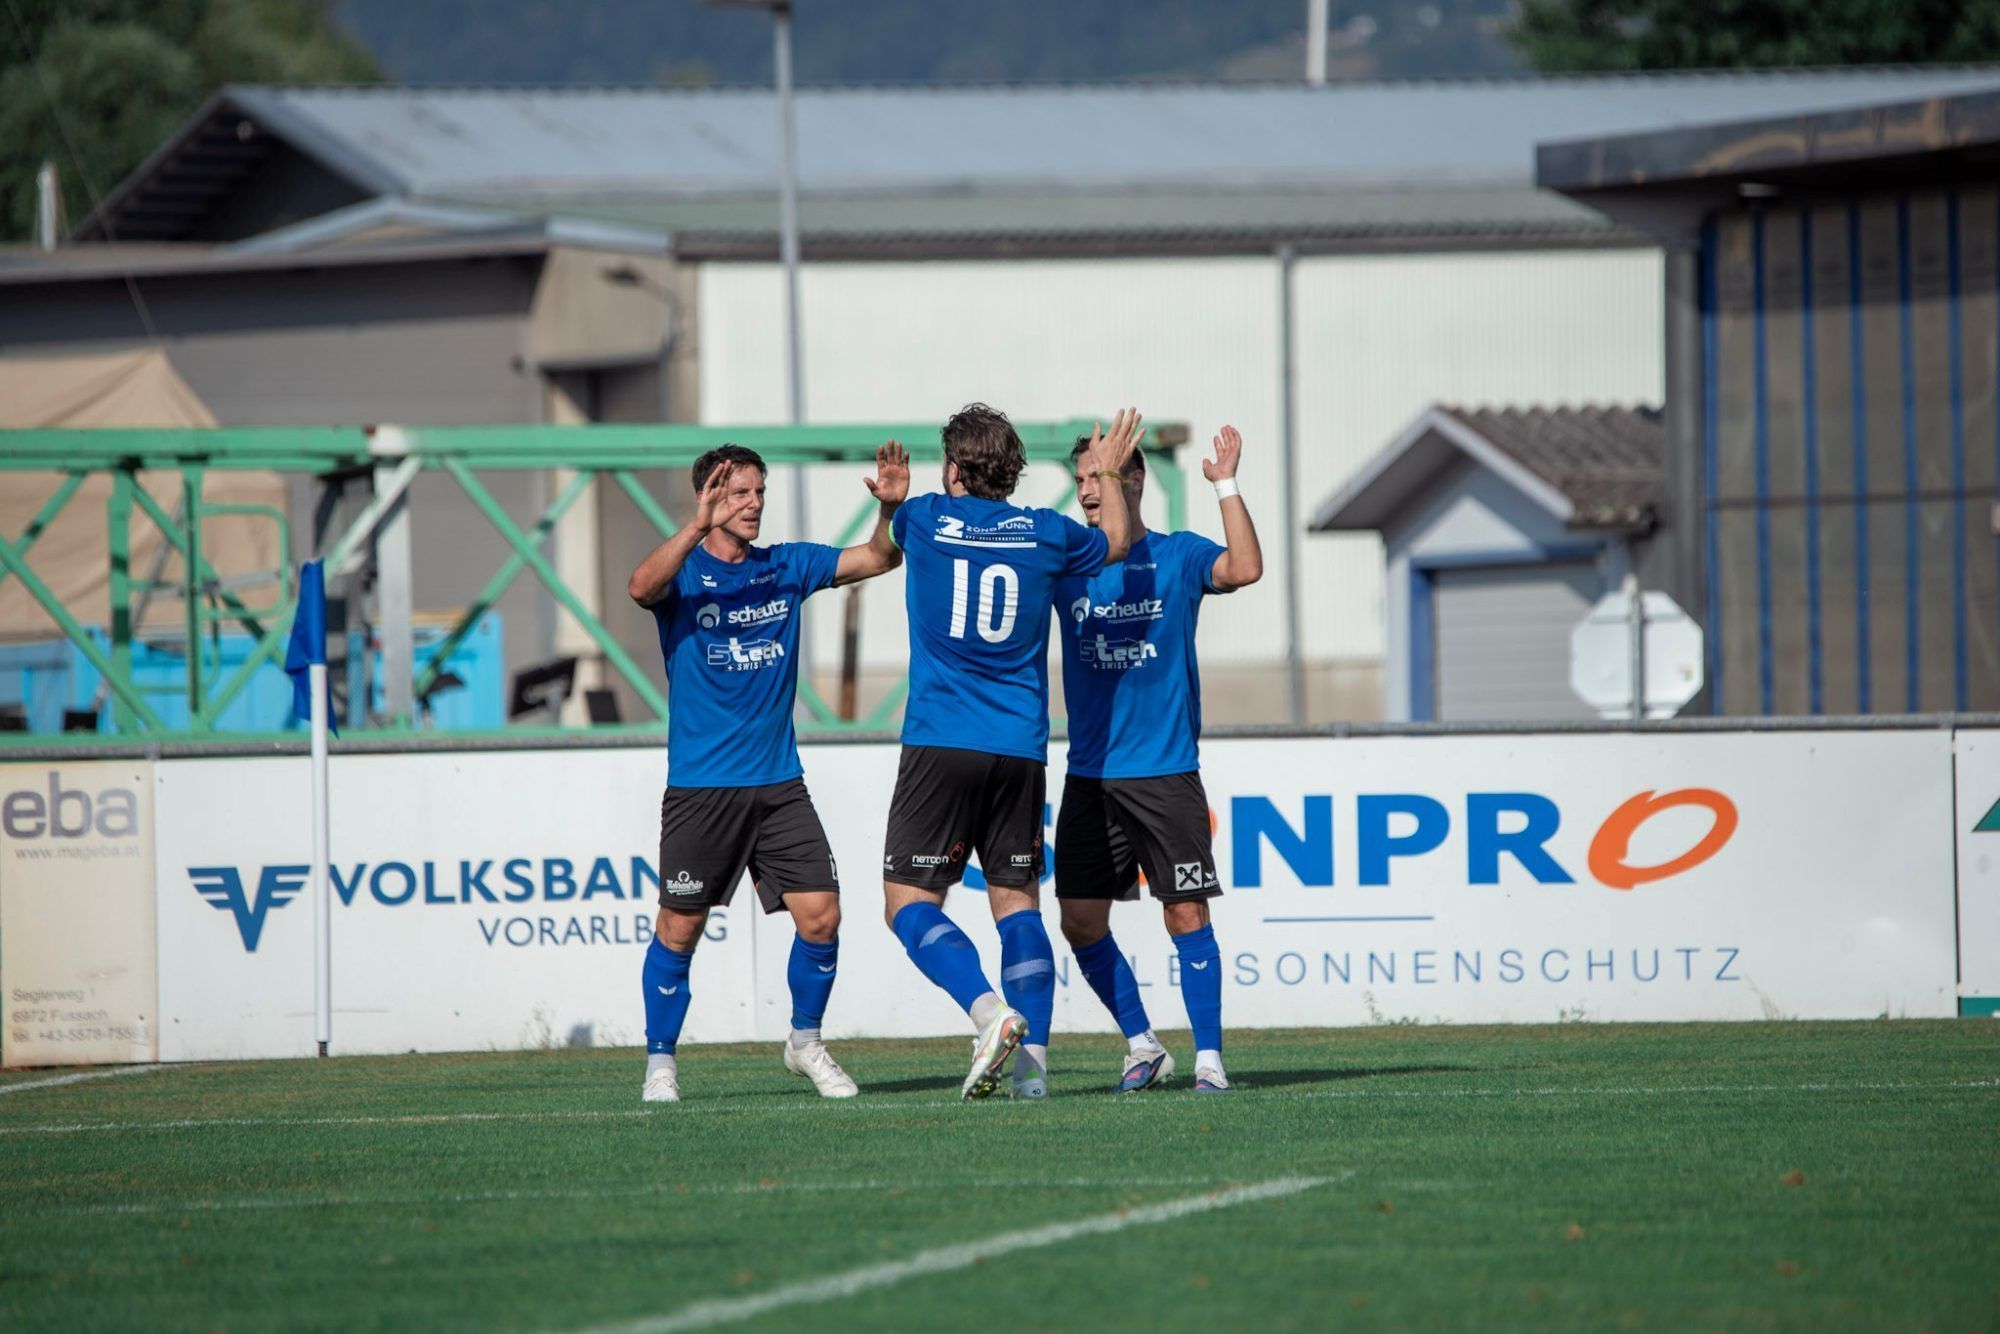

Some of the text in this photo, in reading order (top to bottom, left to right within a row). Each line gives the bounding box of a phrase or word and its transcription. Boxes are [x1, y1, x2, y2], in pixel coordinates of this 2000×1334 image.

[728, 599, 788, 624] scheutz
[949, 558, 1019, 643] 10
[1094, 599, 1162, 618] scheutz
[737, 662, 760, 671] SWIS
[329, 856, 660, 906] VOLKSBAN
[478, 913, 728, 946] VORARLBG
[1233, 947, 1741, 986] SONNENSCHUTZ
